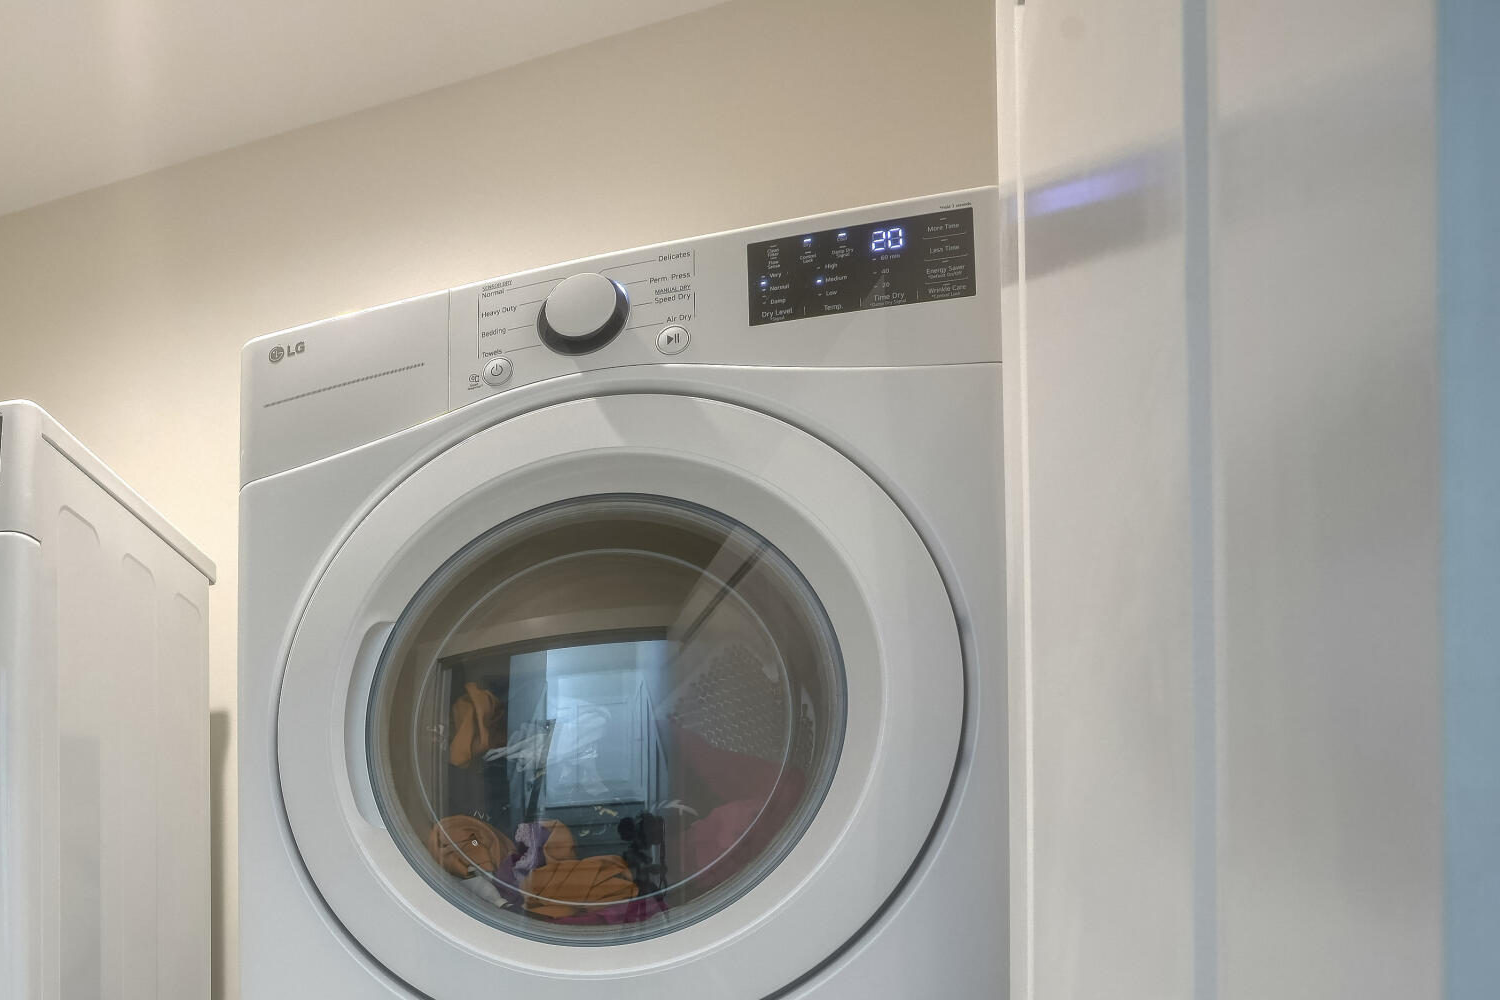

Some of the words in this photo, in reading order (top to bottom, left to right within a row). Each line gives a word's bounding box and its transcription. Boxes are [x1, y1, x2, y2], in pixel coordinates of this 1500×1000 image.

[927, 224, 944, 232] More
[871, 227, 903, 251] 20
[658, 251, 691, 262] Delicates
[926, 268, 947, 276] Energy
[826, 275, 848, 283] Medium
[482, 288, 505, 299] Normal
[655, 287, 677, 295] MANUAL
[770, 284, 789, 292] Normal
[928, 286, 951, 294] Wrinkle
[655, 295, 676, 304] Speed
[678, 292, 691, 301] Dry
[874, 294, 890, 302] Time
[892, 291, 905, 299] Dry
[482, 309, 500, 318] Heavy
[502, 305, 517, 314] Duty
[762, 311, 774, 319] Dry
[775, 307, 793, 316] Level
[482, 327, 507, 338] Bedding
[287, 341, 305, 357] LG
[483, 348, 503, 358] Towels
